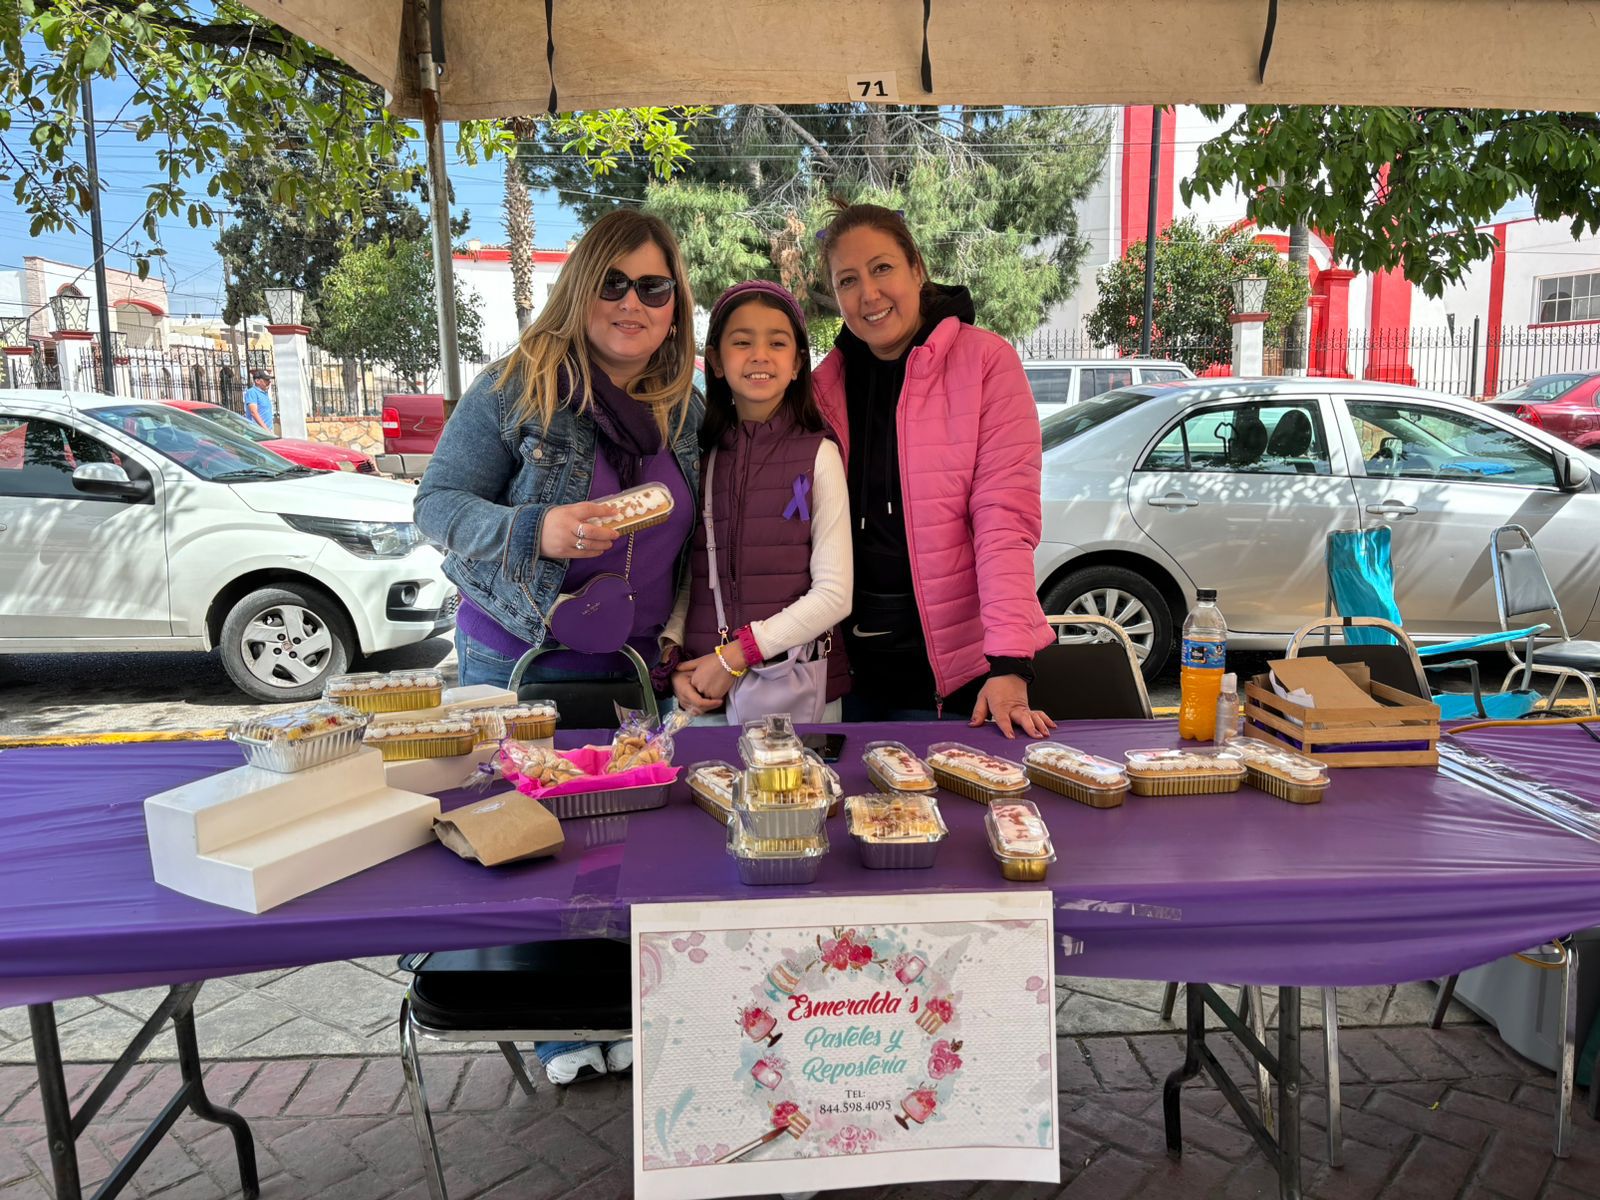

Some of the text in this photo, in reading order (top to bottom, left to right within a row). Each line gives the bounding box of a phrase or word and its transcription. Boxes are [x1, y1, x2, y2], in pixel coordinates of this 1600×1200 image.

[857, 80, 888, 97] 71
[804, 1025, 903, 1053] Pasteles y
[819, 1100, 892, 1115] 844.598.4095
